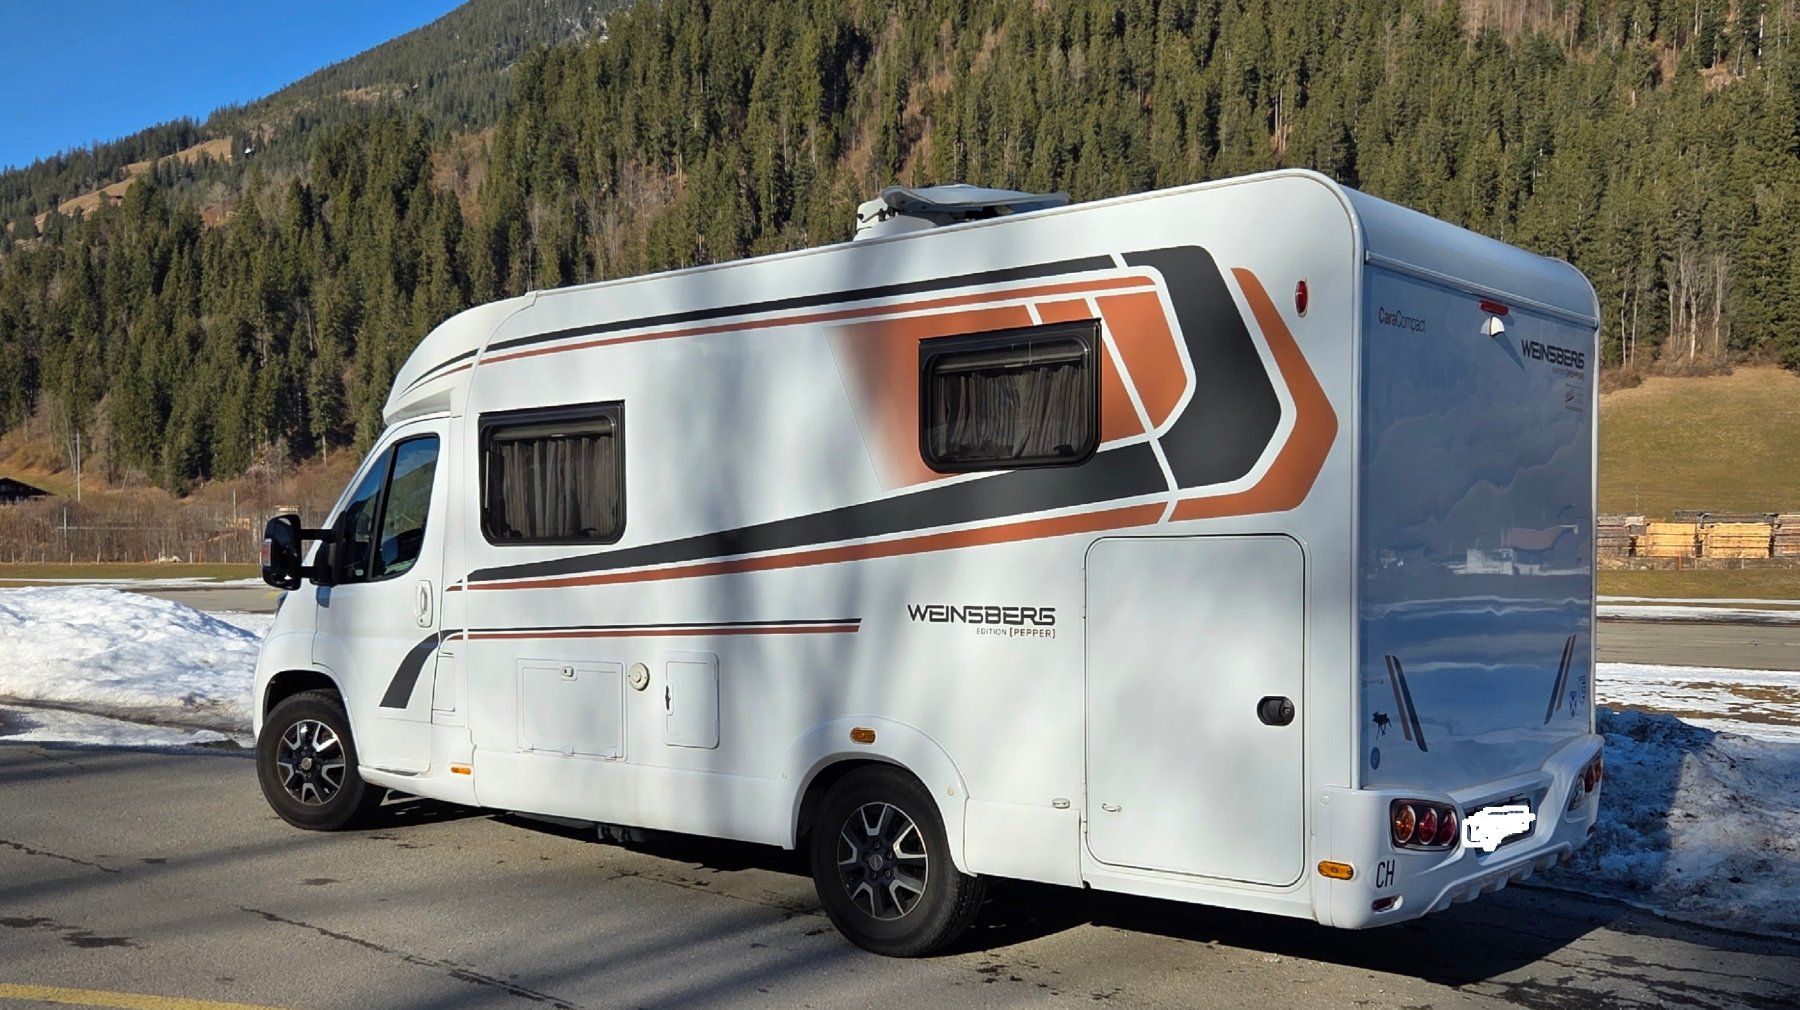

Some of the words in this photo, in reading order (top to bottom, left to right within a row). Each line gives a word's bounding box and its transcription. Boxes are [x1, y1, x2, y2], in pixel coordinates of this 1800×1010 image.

[1378, 306, 1426, 333] CaraCompact
[1521, 339, 1585, 369] WEINSBERG
[907, 604, 1056, 626] WEINSBERG
[976, 628, 1007, 636] EDITION
[1009, 627, 1056, 639] [PEPPER]
[1376, 859, 1395, 888] CH
